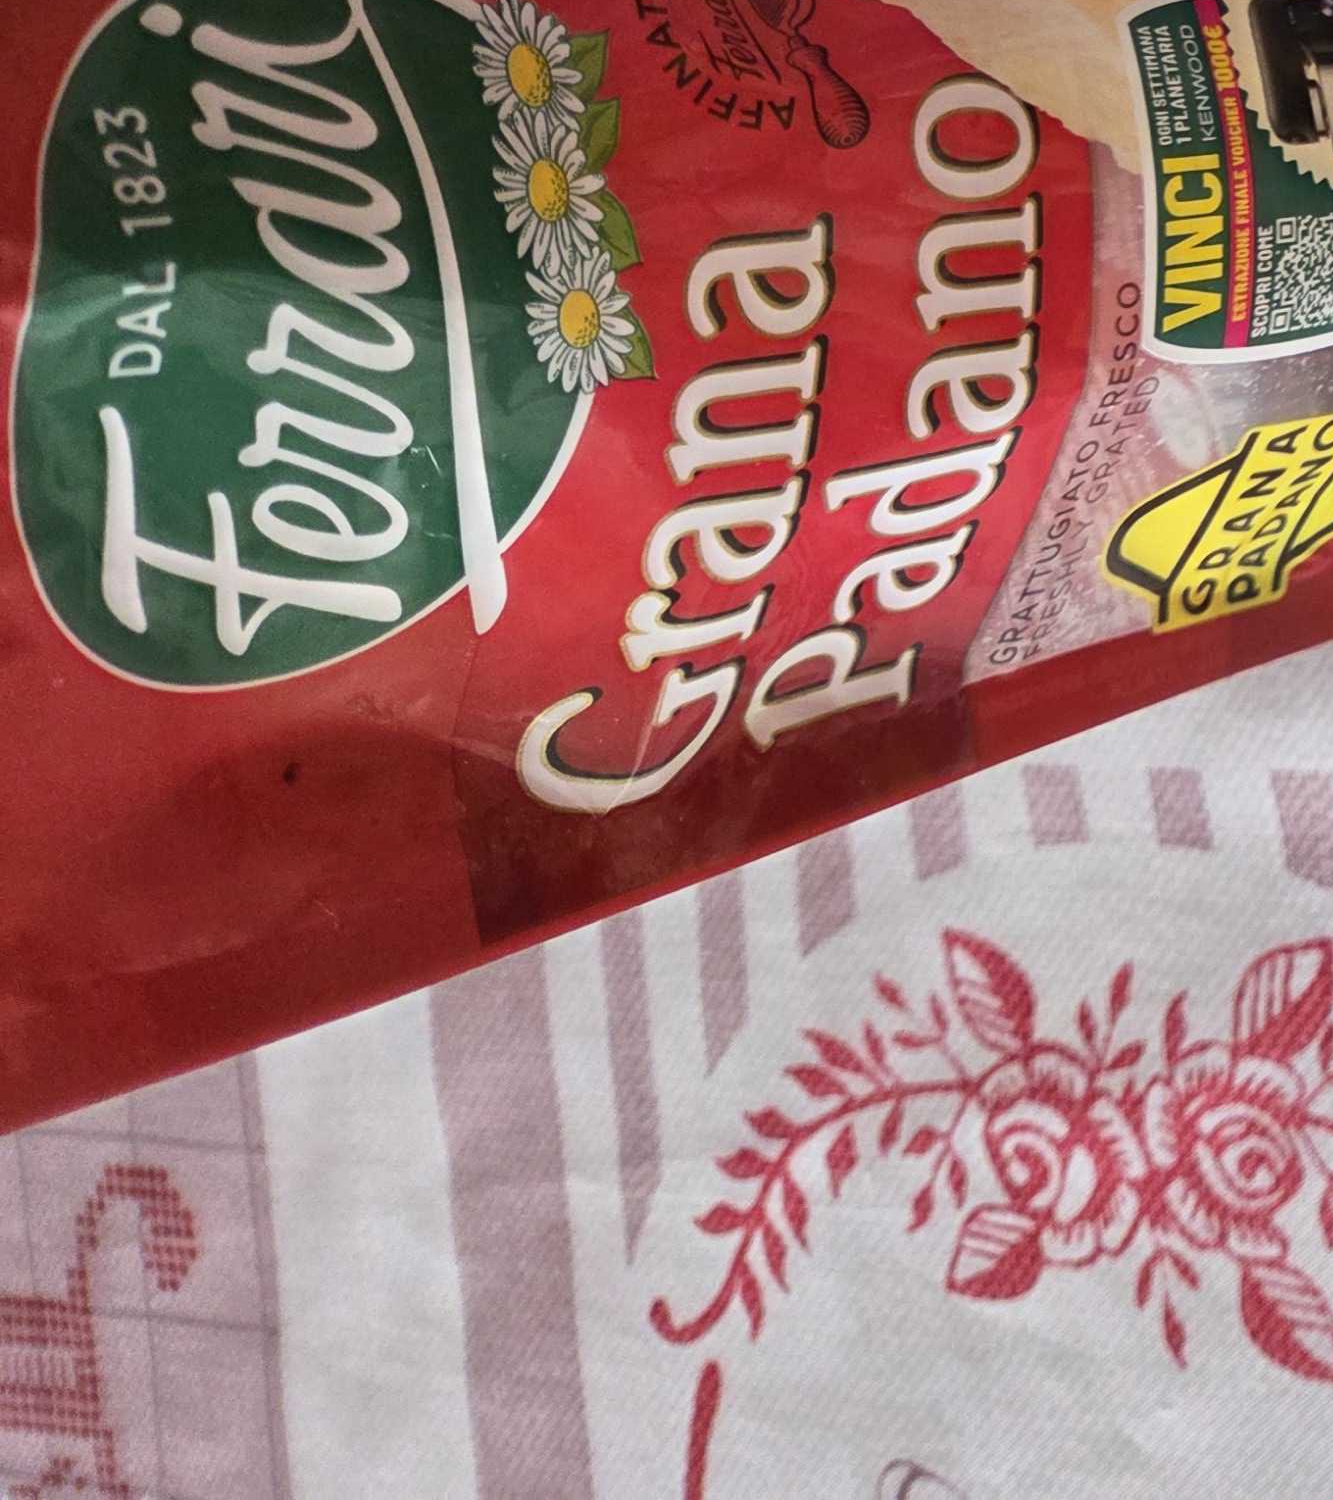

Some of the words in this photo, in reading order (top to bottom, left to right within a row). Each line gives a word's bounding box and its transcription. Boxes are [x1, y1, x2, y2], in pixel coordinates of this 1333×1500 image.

[1136, 25, 1167, 107] SETTIMANA
[1153, 24, 1191, 132] PLANETARIA
[1179, 23, 1217, 142] KENWOOD
[1203, 24, 1236, 92] 1000€
[94, 105, 174, 237] 1823
[1154, 110, 1173, 146] OGNI
[1176, 136, 1192, 145] 1
[1225, 96, 1246, 166] VOUCHER
[1161, 153, 1225, 333] VINCI
[1233, 170, 1251, 224] FINALE
[1257, 225, 1274, 268] COME
[108, 261, 177, 379] DAL
[1230, 227, 1251, 323] ESTRAZIONE
[1251, 270, 1272, 338] SCOPRI
[742, 72, 1042, 752] Padano
[516, 212, 832, 816] Grana
[989, 440, 1099, 665] GRATTUGIATO
[1091, 281, 1142, 428] FRESCO
[1022, 518, 1094, 661] FRESHLY
[1086, 375, 1160, 505] GRATED
[1181, 425, 1308, 615] GRANA
